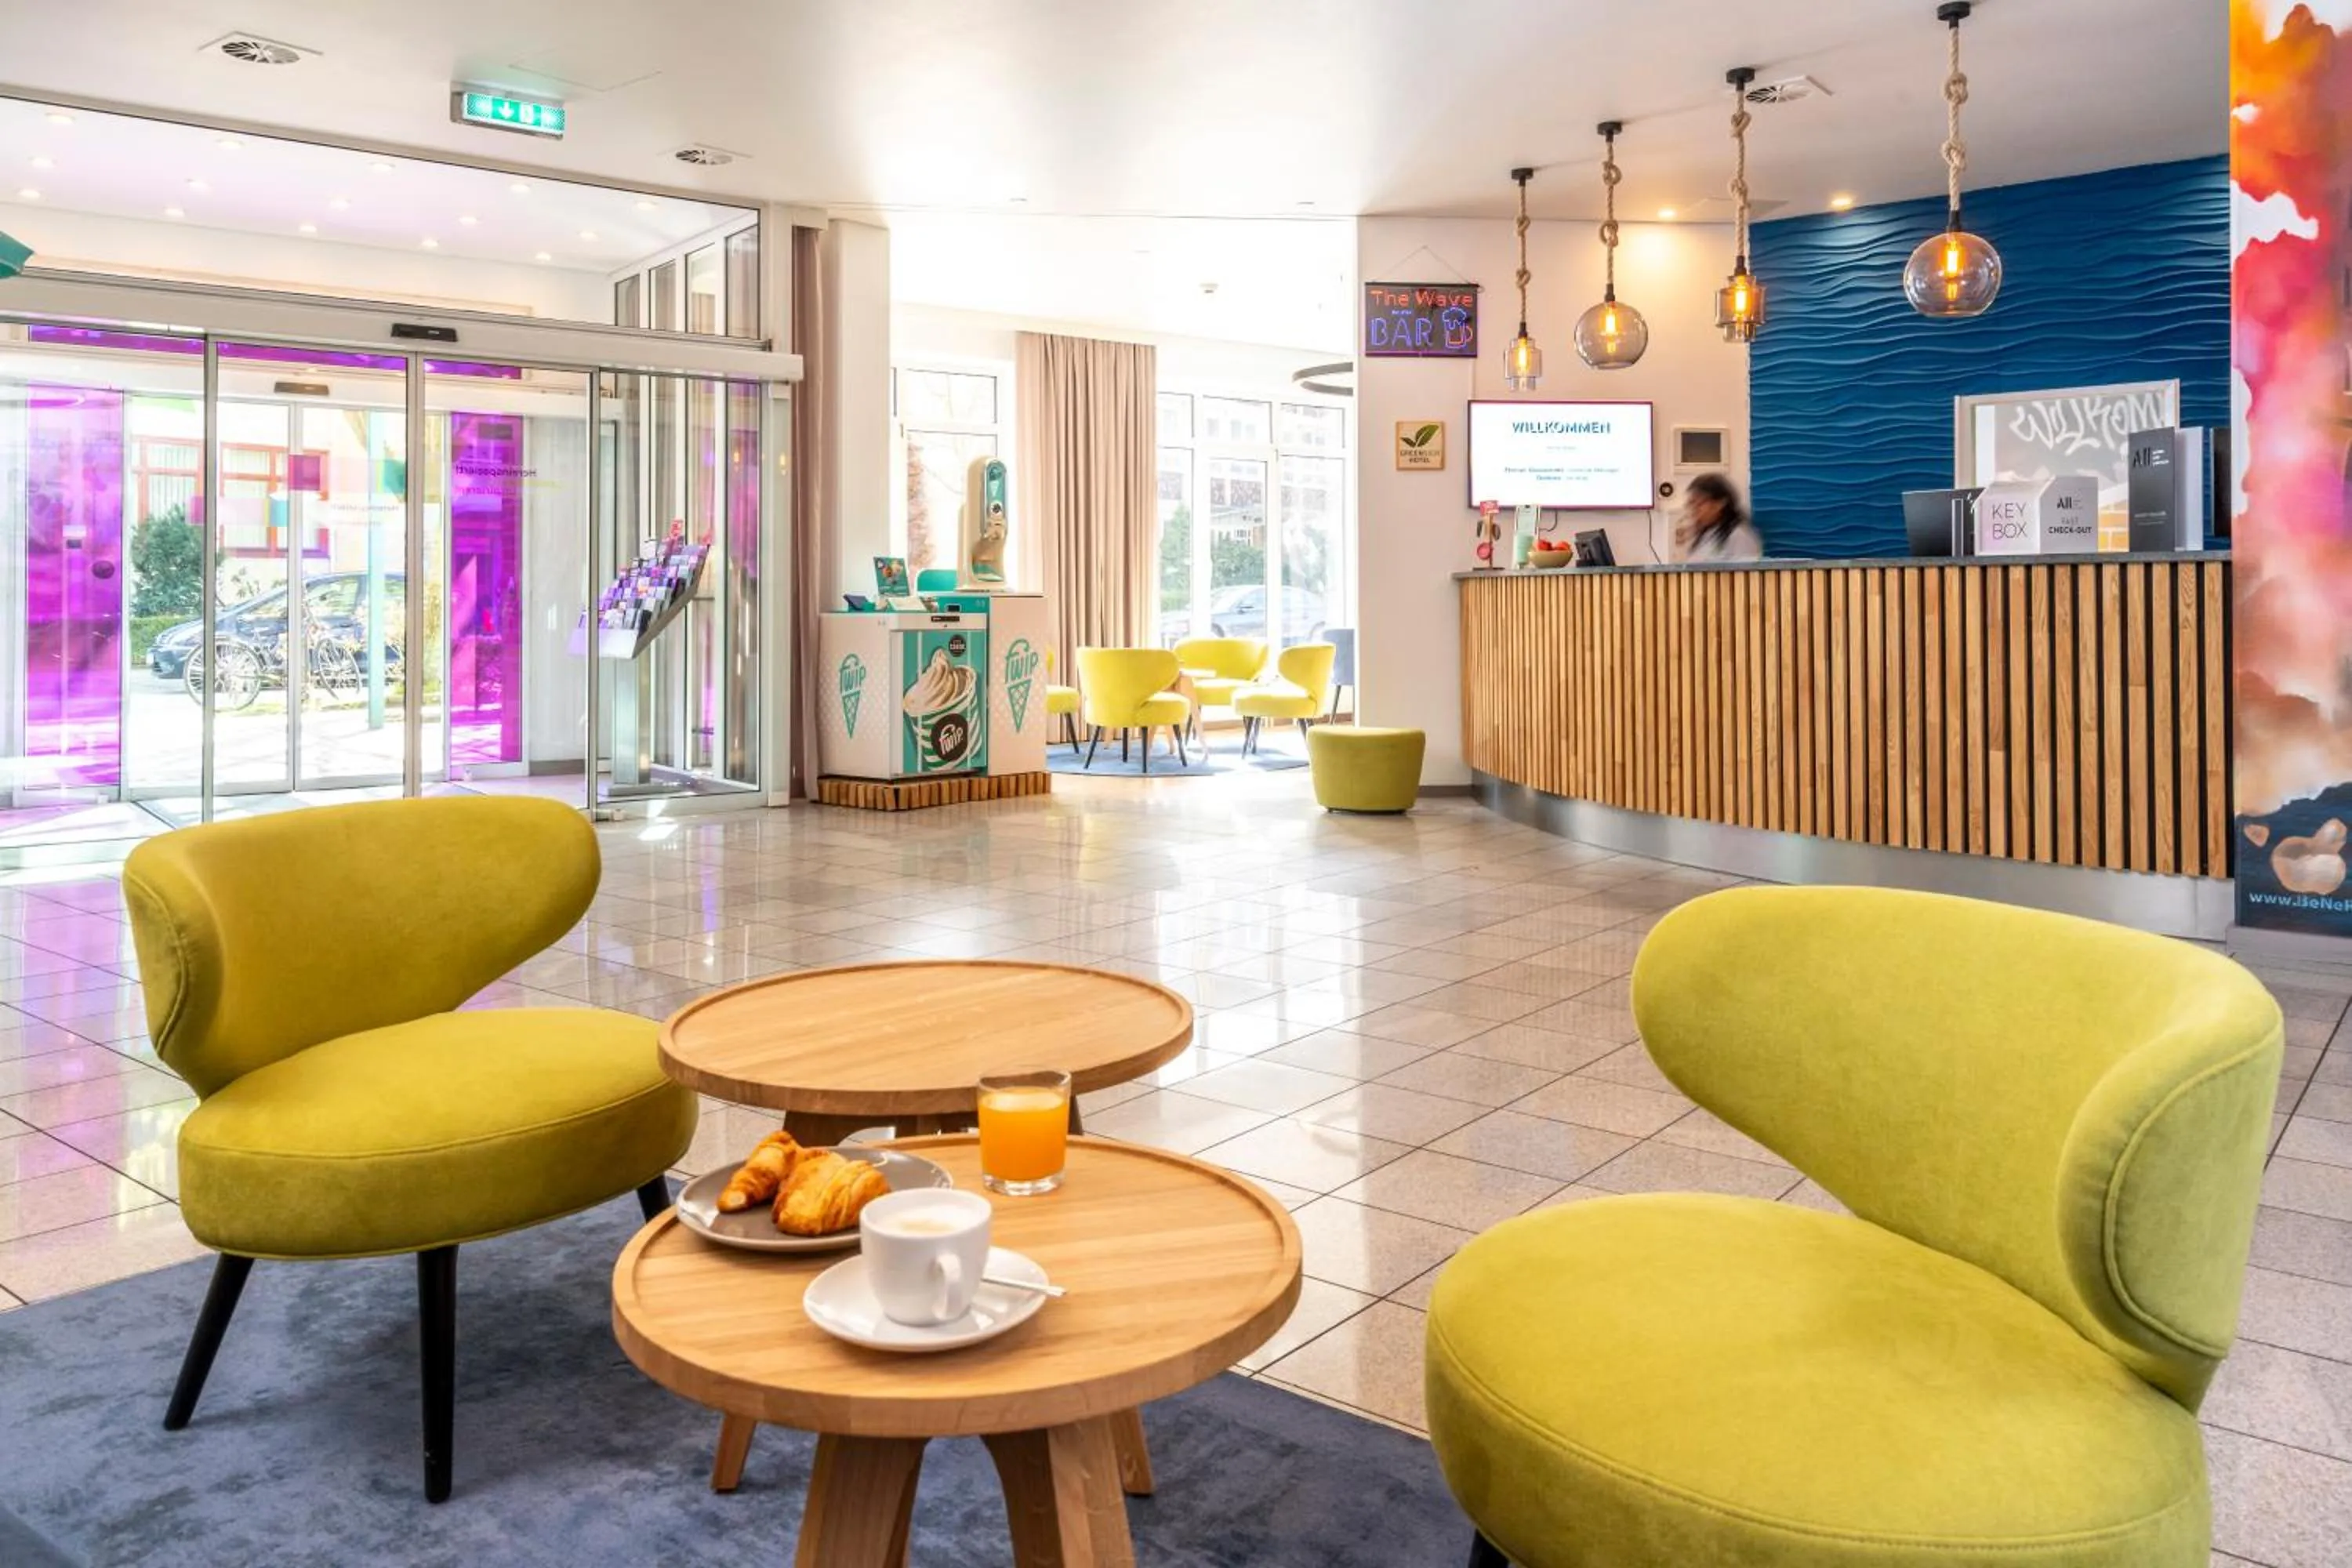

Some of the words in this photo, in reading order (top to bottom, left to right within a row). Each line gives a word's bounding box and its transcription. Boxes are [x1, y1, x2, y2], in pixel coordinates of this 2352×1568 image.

[1370, 289, 1410, 307] The
[1415, 289, 1473, 307] Wave
[1370, 317, 1434, 347] BAR
[1512, 421, 1611, 434] WILLKOMMEN
[1992, 503, 2027, 519] KEY
[1992, 522, 2027, 540] BOX
[2048, 526, 2092, 535] CHECK-OUT
